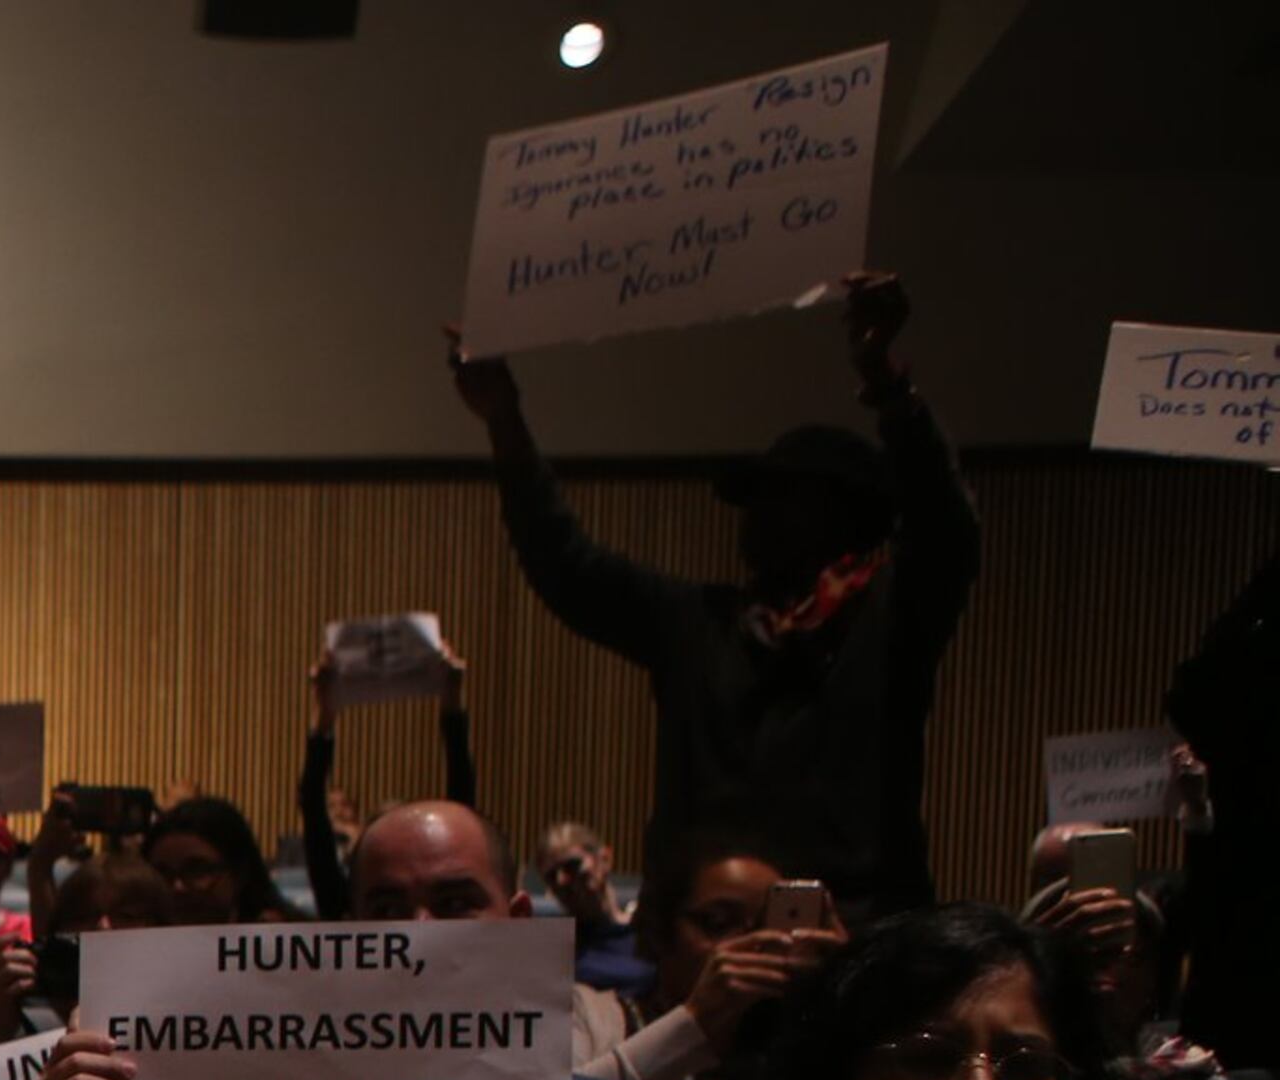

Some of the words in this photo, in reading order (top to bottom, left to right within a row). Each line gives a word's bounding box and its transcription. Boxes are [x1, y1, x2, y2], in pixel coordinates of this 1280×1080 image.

[619, 102, 720, 150] Hunter
[752, 64, 872, 110] Resign
[677, 138, 735, 165] has
[759, 123, 800, 146] no
[568, 181, 665, 221] place
[683, 167, 715, 190] in
[727, 136, 858, 190] politics
[508, 240, 651, 294] Hunter
[671, 211, 753, 254] Must
[1139, 393, 1207, 417] Does
[1220, 396, 1280, 419] not
[1236, 420, 1274, 446] of
[218, 932, 426, 976] HUNTER,
[108, 1010, 544, 1053] EMBARRASSMENT
